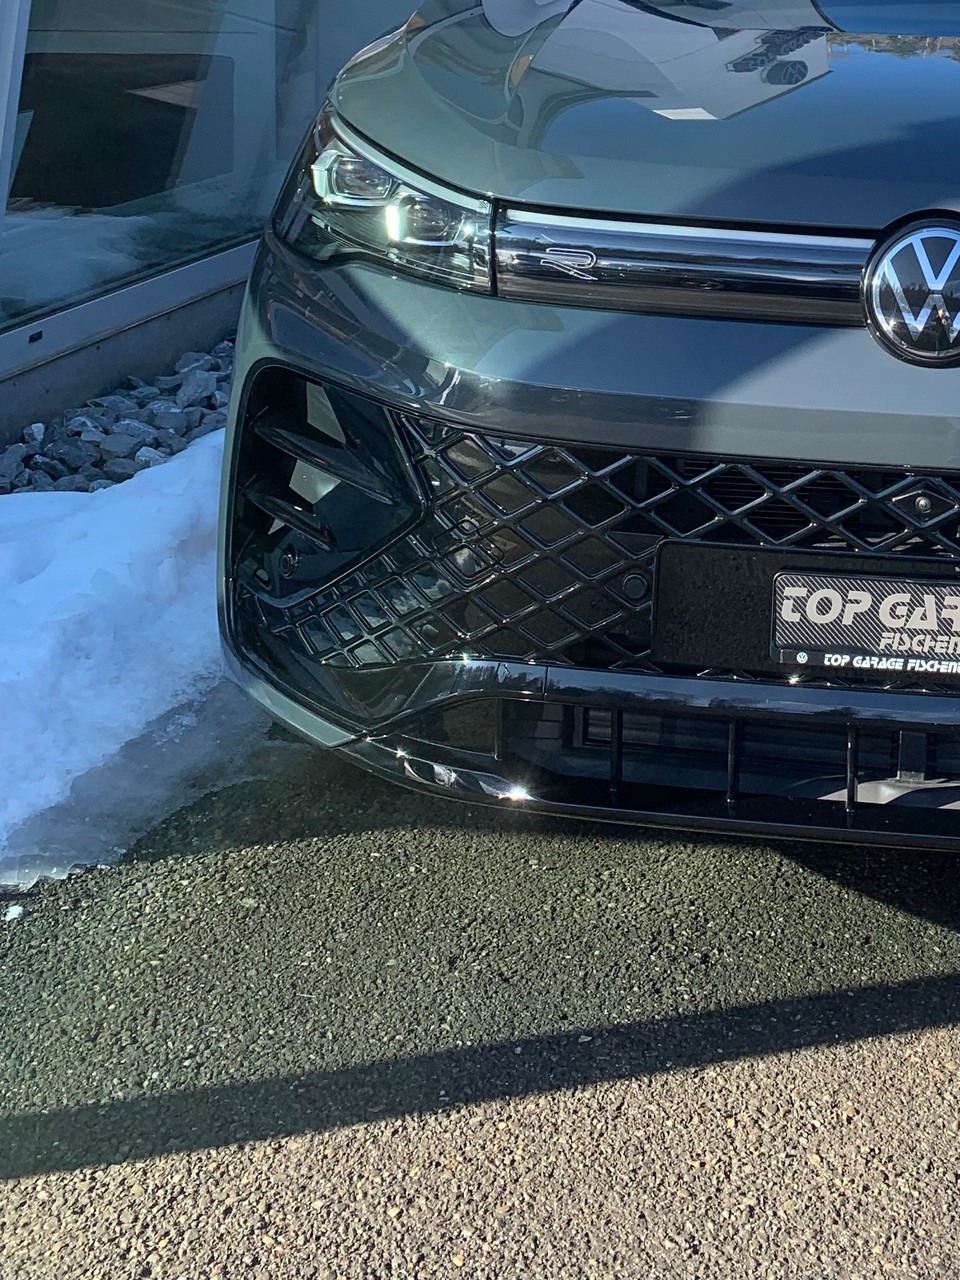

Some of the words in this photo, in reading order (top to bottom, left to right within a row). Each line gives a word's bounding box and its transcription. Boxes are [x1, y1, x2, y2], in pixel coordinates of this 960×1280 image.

[780, 586, 873, 626] TOP
[823, 653, 851, 667] TOP
[852, 655, 905, 670] GARAGE
